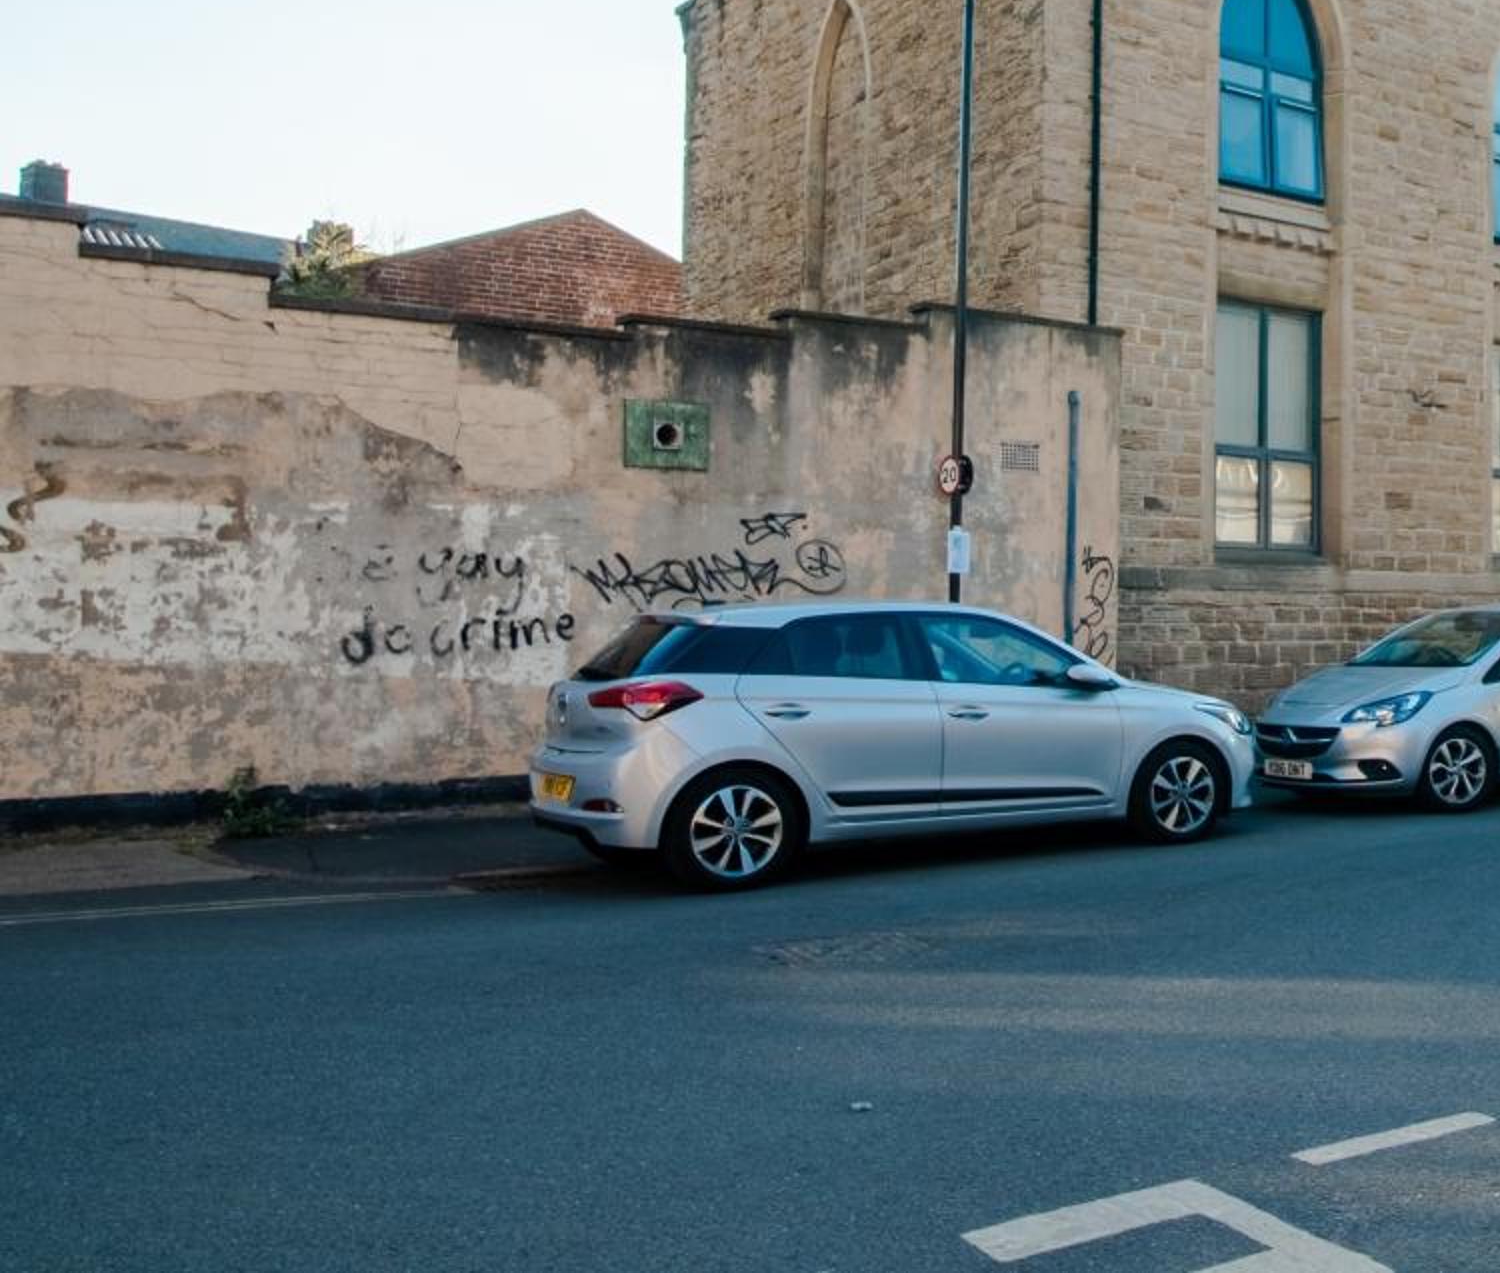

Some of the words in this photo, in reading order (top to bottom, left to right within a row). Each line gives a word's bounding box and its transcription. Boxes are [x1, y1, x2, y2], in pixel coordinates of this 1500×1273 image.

[941, 466, 957, 484] 20
[417, 547, 524, 615] gay
[429, 612, 575, 657] crime
